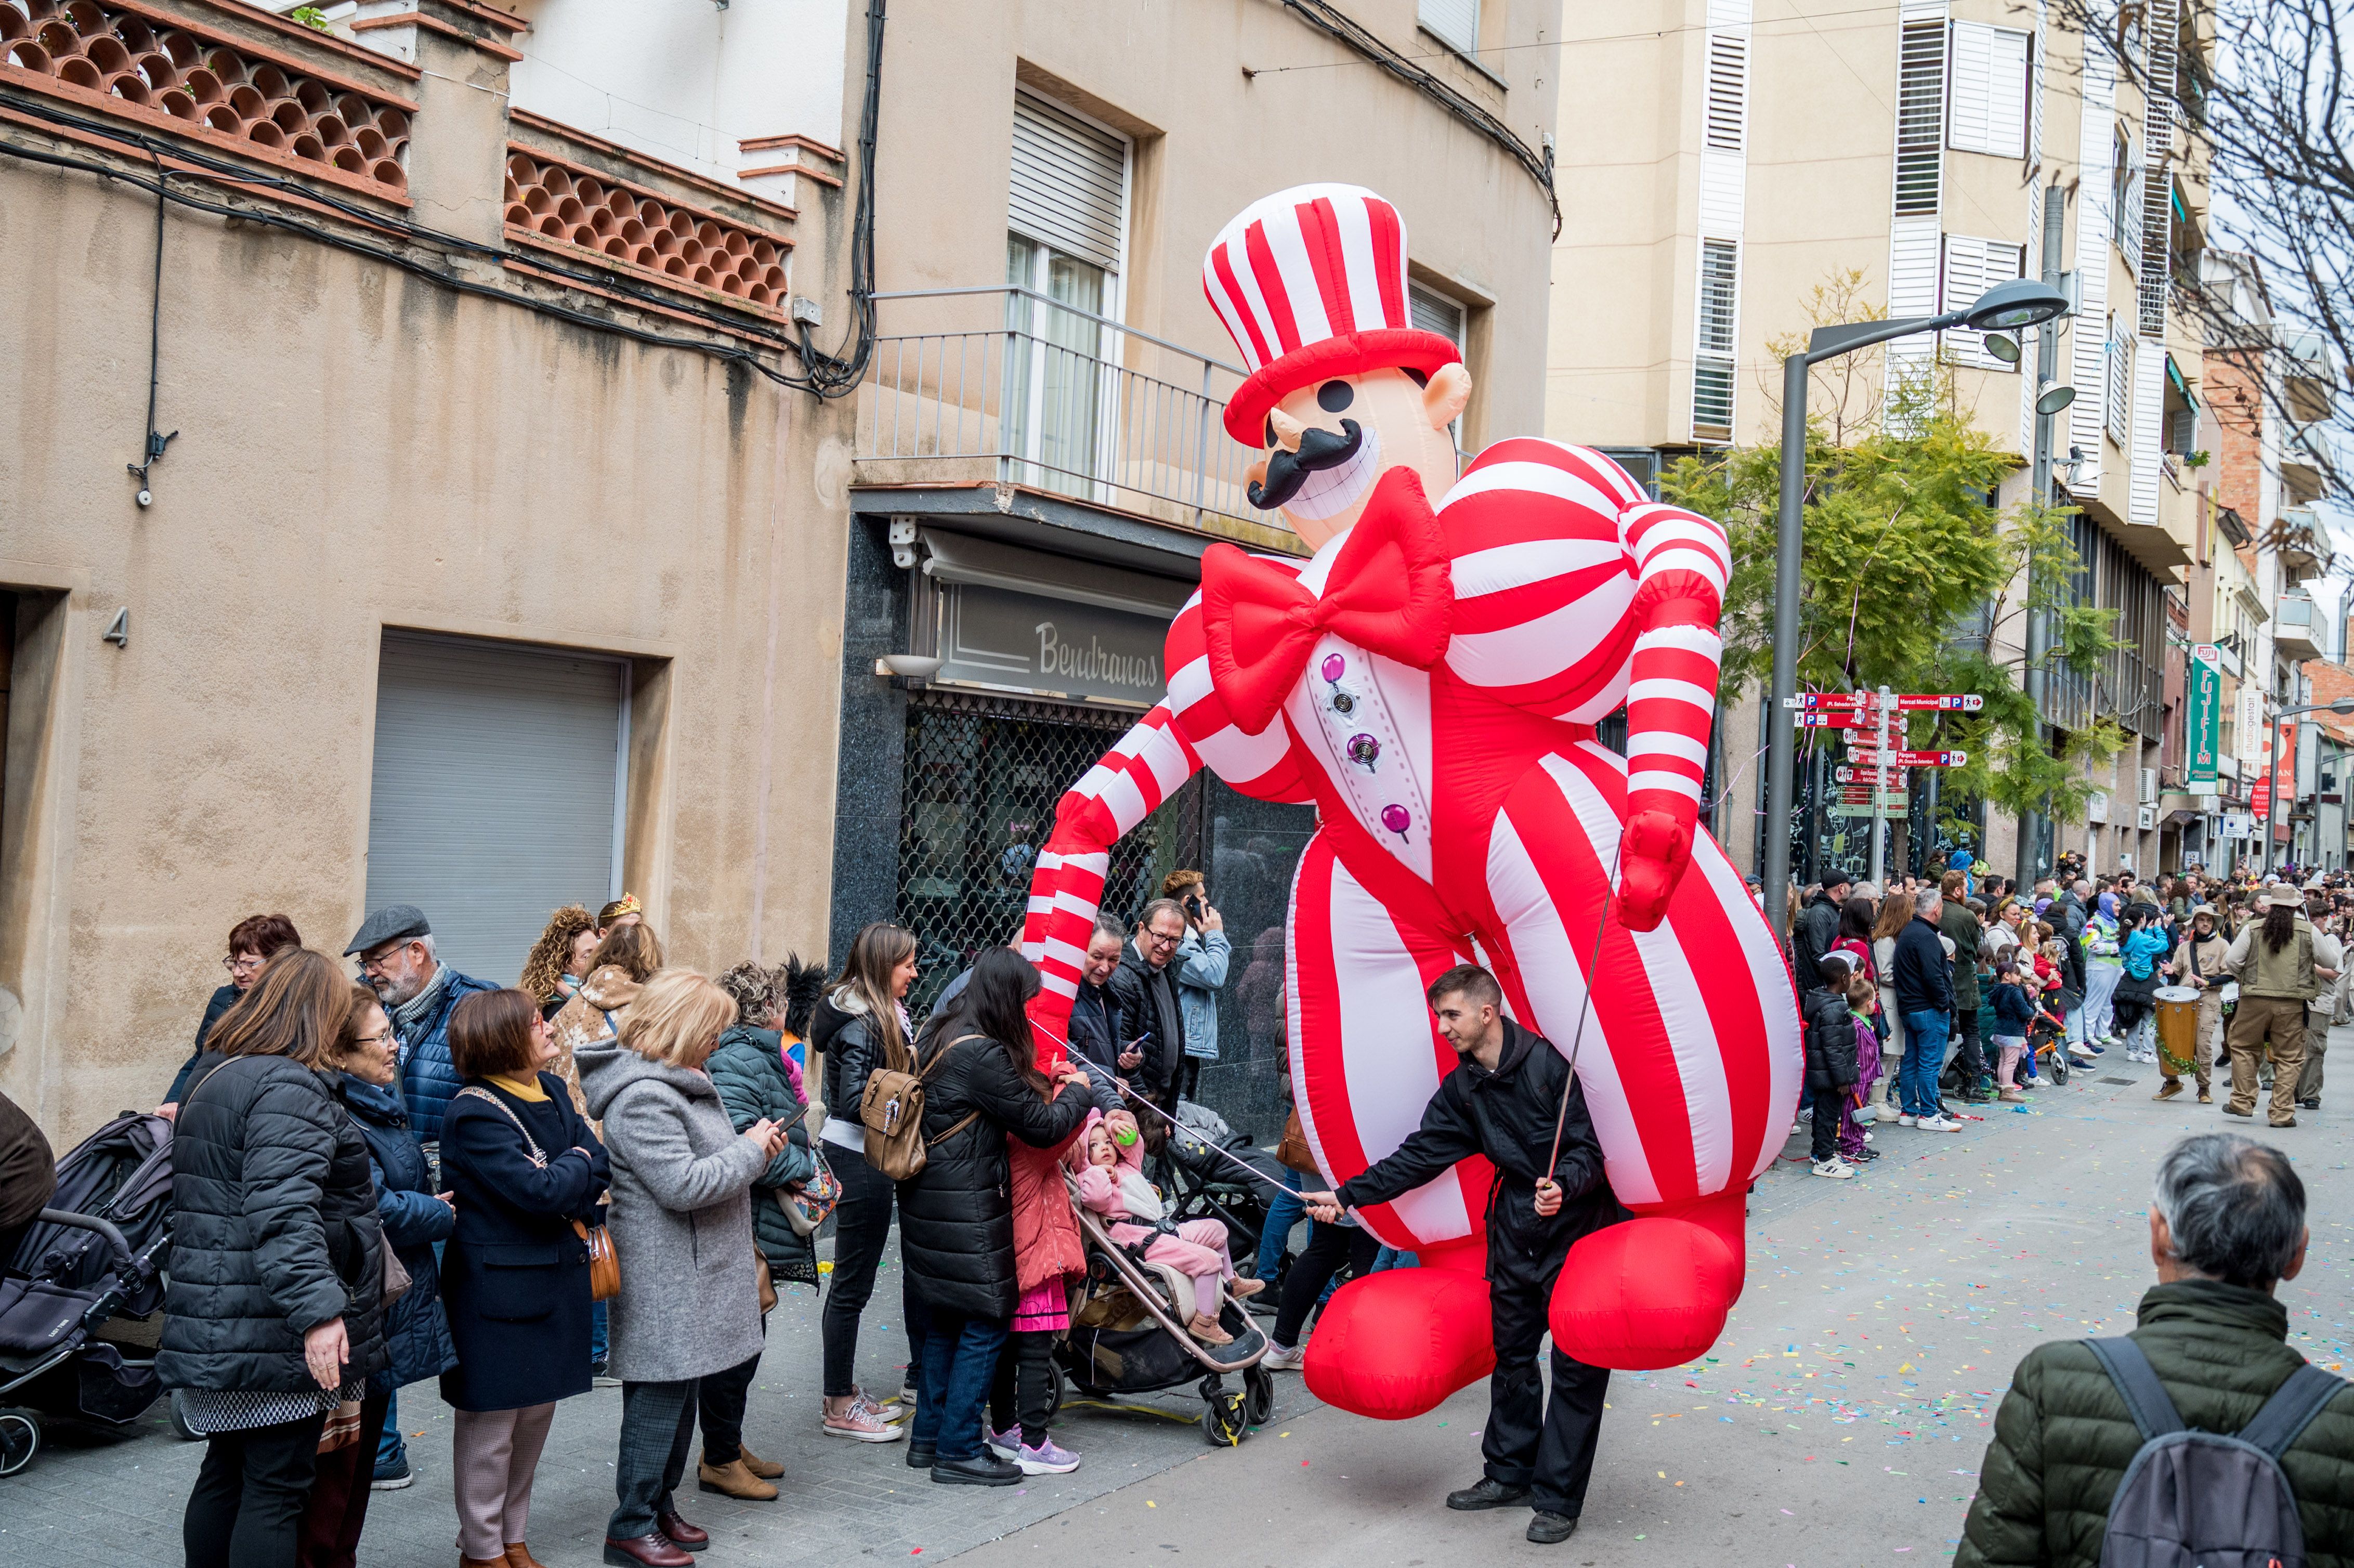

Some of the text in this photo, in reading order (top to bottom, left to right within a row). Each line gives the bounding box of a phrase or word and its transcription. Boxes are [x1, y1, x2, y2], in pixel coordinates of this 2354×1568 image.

[102, 606, 127, 647] 4
[2198, 646, 2215, 659] FUJI
[2197, 670, 2212, 765] FUJIFILM
